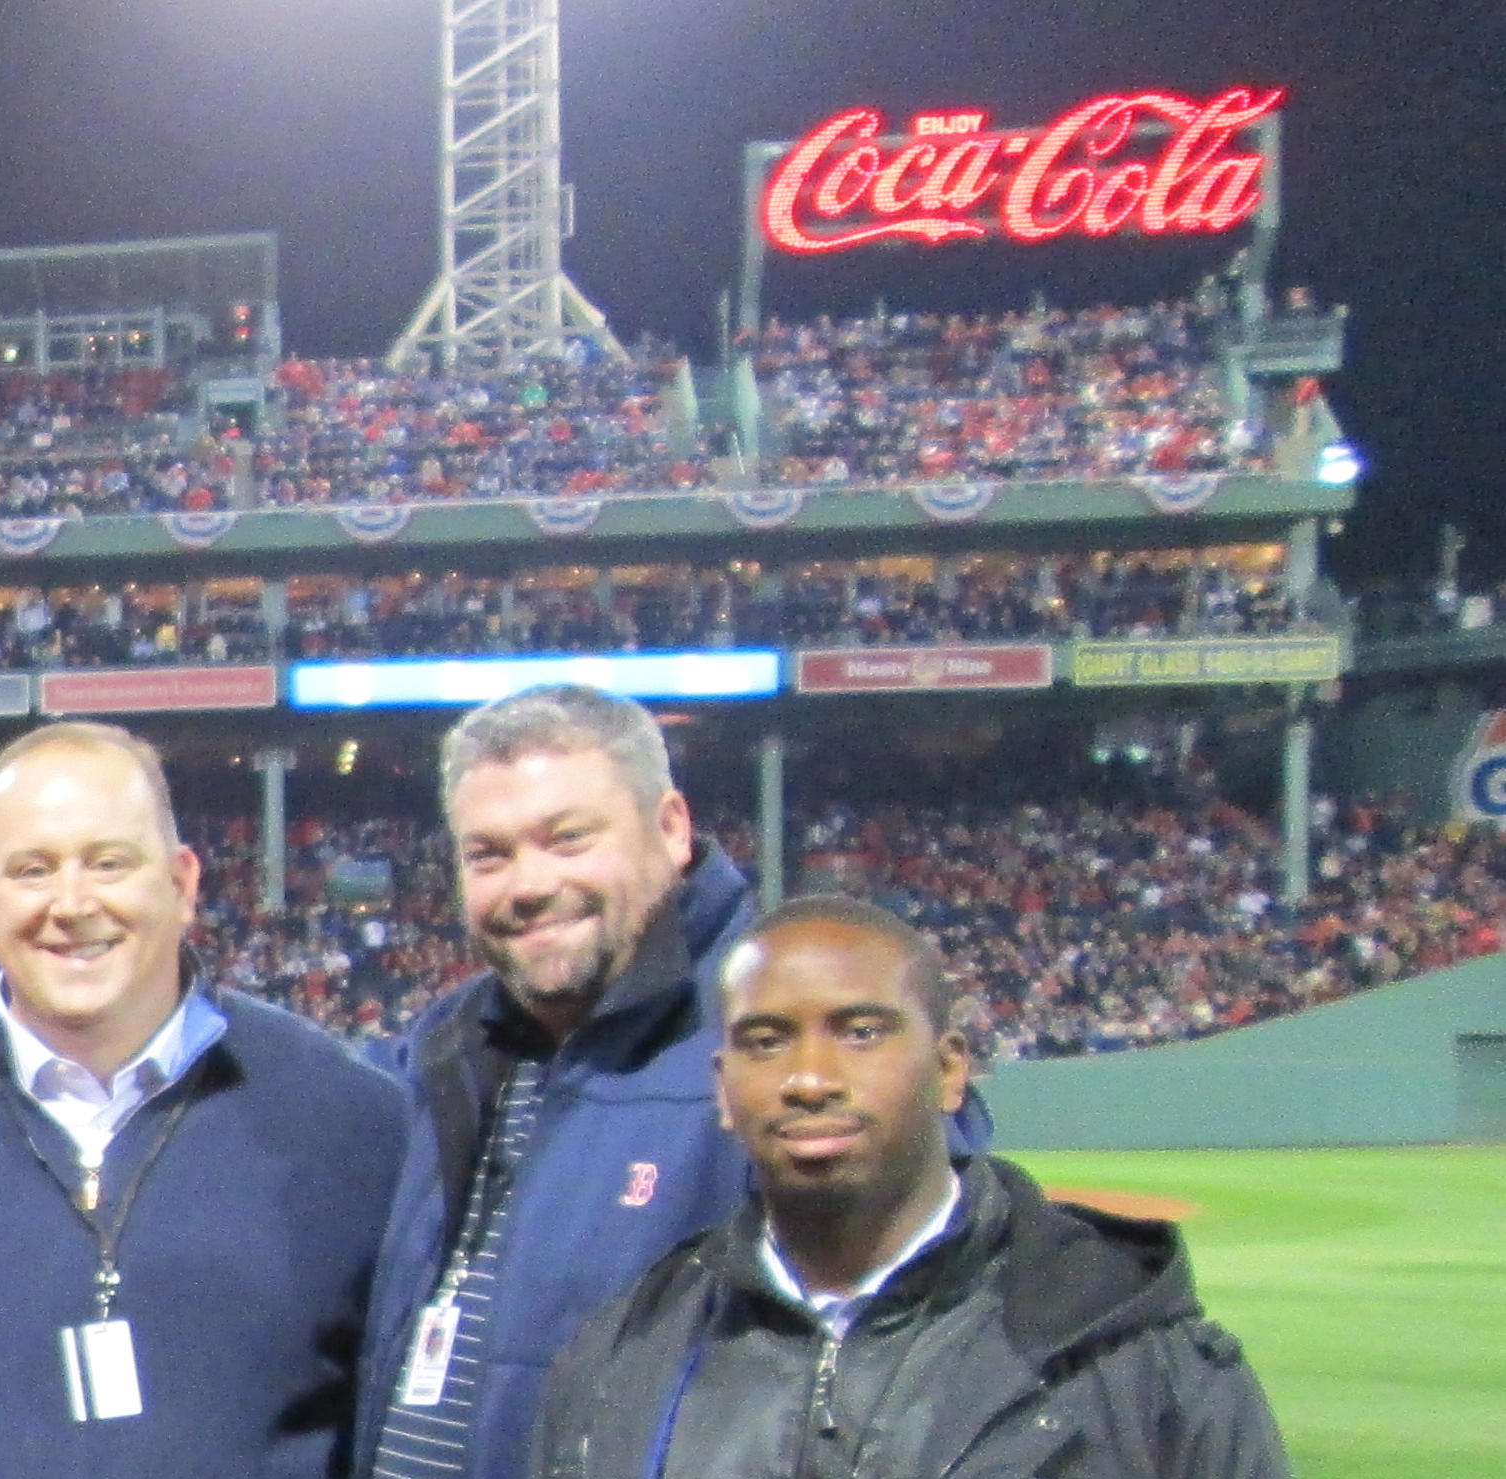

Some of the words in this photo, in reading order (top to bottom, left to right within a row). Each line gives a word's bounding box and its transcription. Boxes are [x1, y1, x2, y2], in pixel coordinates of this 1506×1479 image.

[918, 115, 984, 136] ENJOY
[766, 87, 1286, 252] Coca-Cola
[621, 1162, 658, 1206] B
